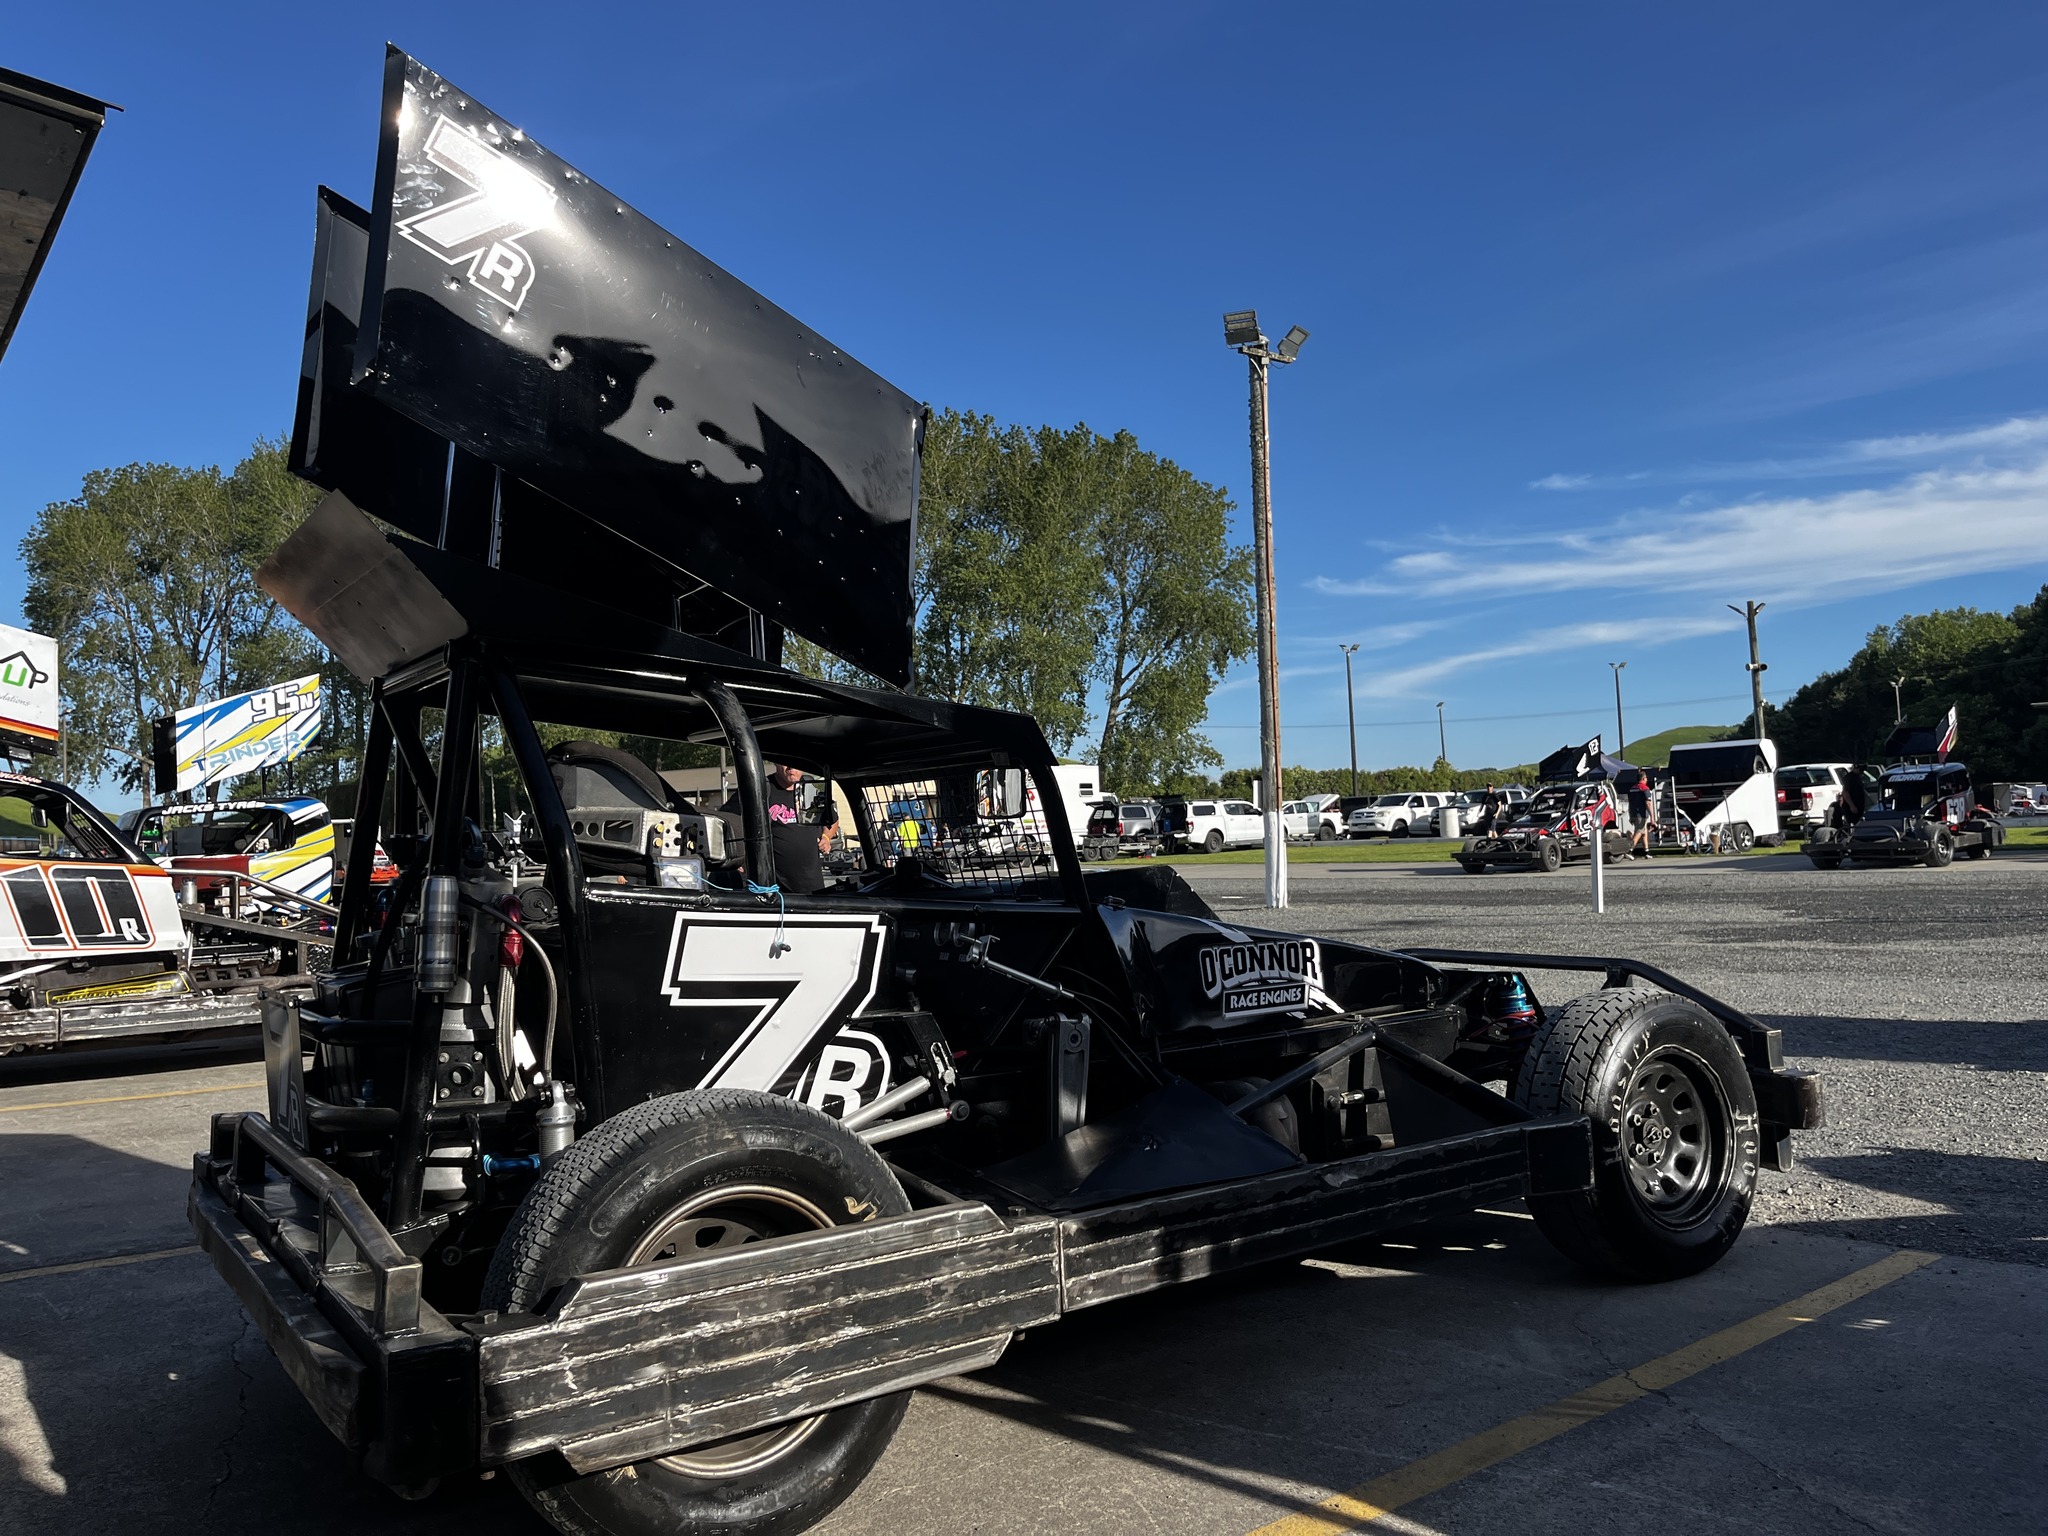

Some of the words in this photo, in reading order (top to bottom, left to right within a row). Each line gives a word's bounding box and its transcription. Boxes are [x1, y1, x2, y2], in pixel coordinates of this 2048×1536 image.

[191, 730, 300, 772] TRINDER
[1200, 940, 1323, 998] O'CONNOR
[1230, 993, 1258, 1009] RACE
[1260, 988, 1302, 1006] ENGINES
